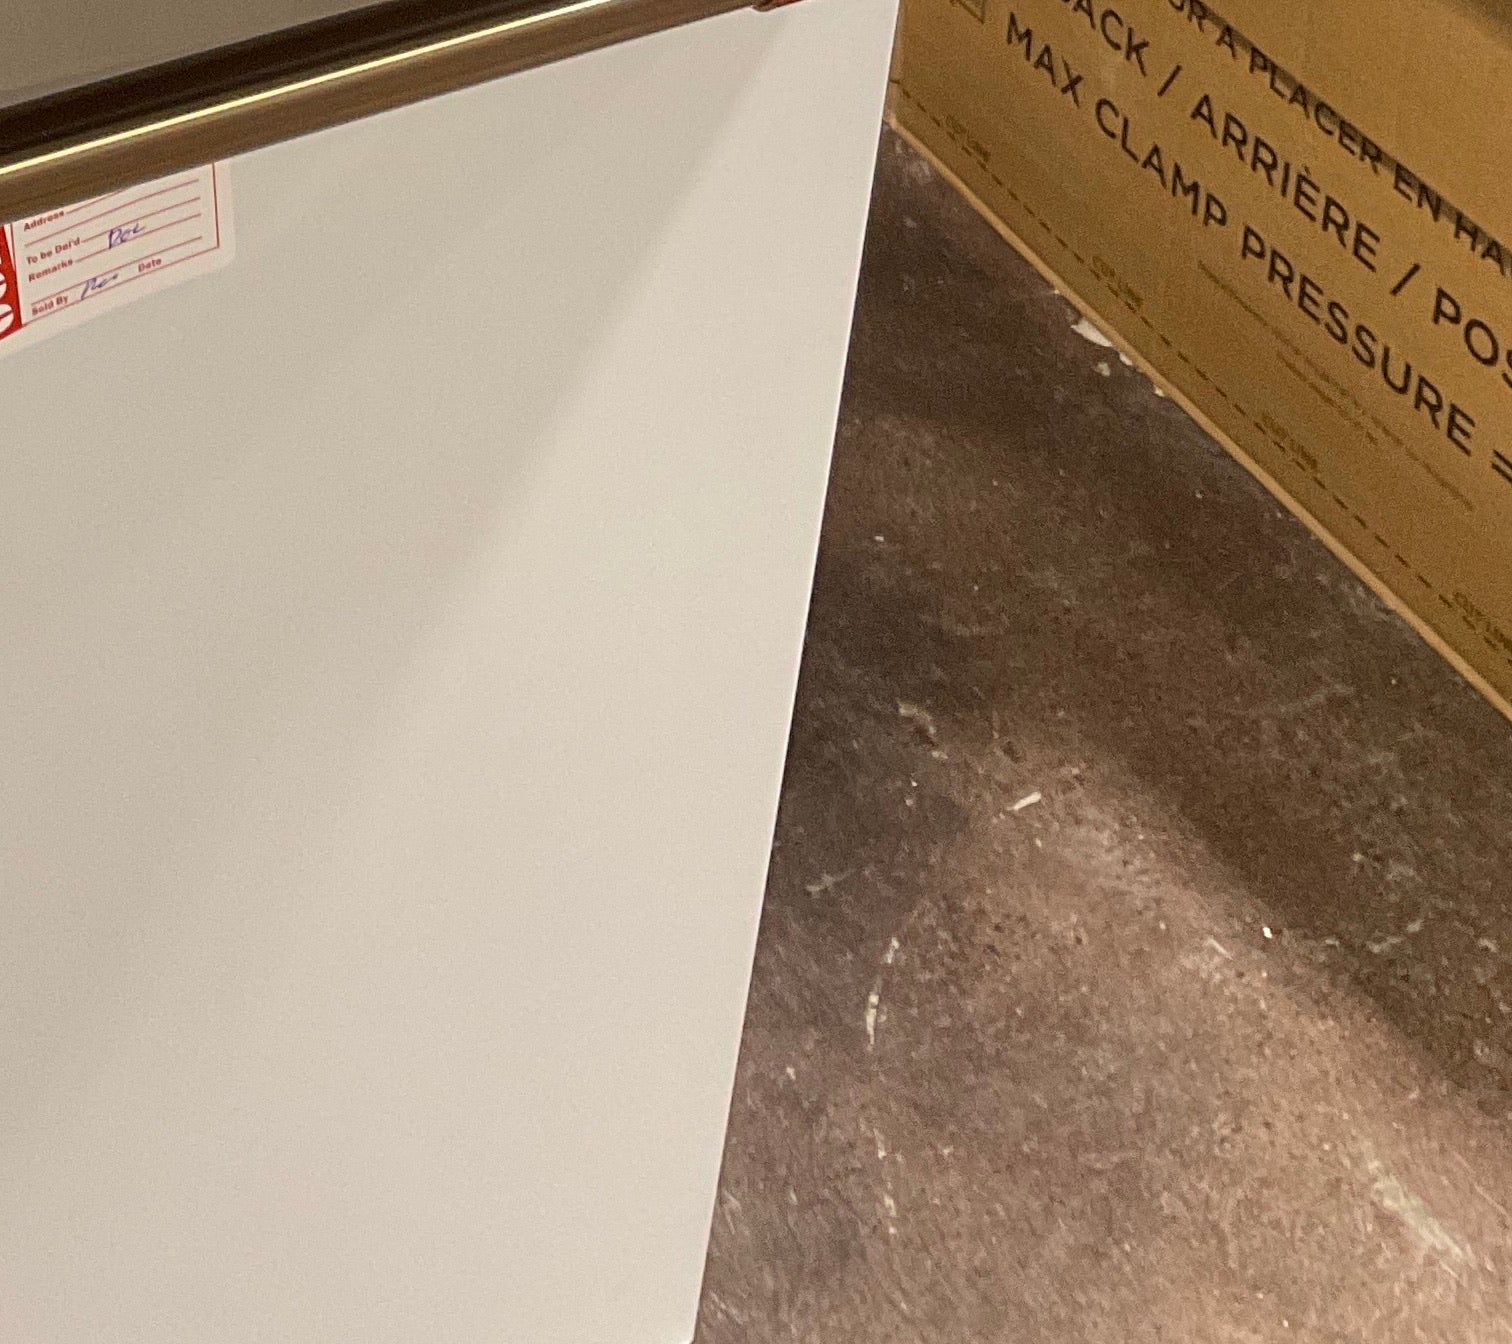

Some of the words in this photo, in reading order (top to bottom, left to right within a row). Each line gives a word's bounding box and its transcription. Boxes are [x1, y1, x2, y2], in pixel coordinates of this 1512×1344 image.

[1249, 46, 1385, 175] PLACER
[1393, 162, 1442, 223] EN
[1454, 208, 1512, 278] HA
[1157, 64, 1183, 97] /
[1190, 93, 1380, 274] ARRIÈRE
[1390, 263, 1421, 297] /
[24, 210, 65, 232] Address
[1006, 11, 1084, 110] MAX
[1094, 97, 1227, 227] CLAMP
[1242, 215, 1476, 458] PRESSURE
[26, 255, 38, 265] To
[40, 250, 52, 260] be
[138, 256, 162, 273] Date
[28, 258, 73, 283] Remarks
[31, 300, 54, 316] Sold
[56, 295, 69, 306] By
